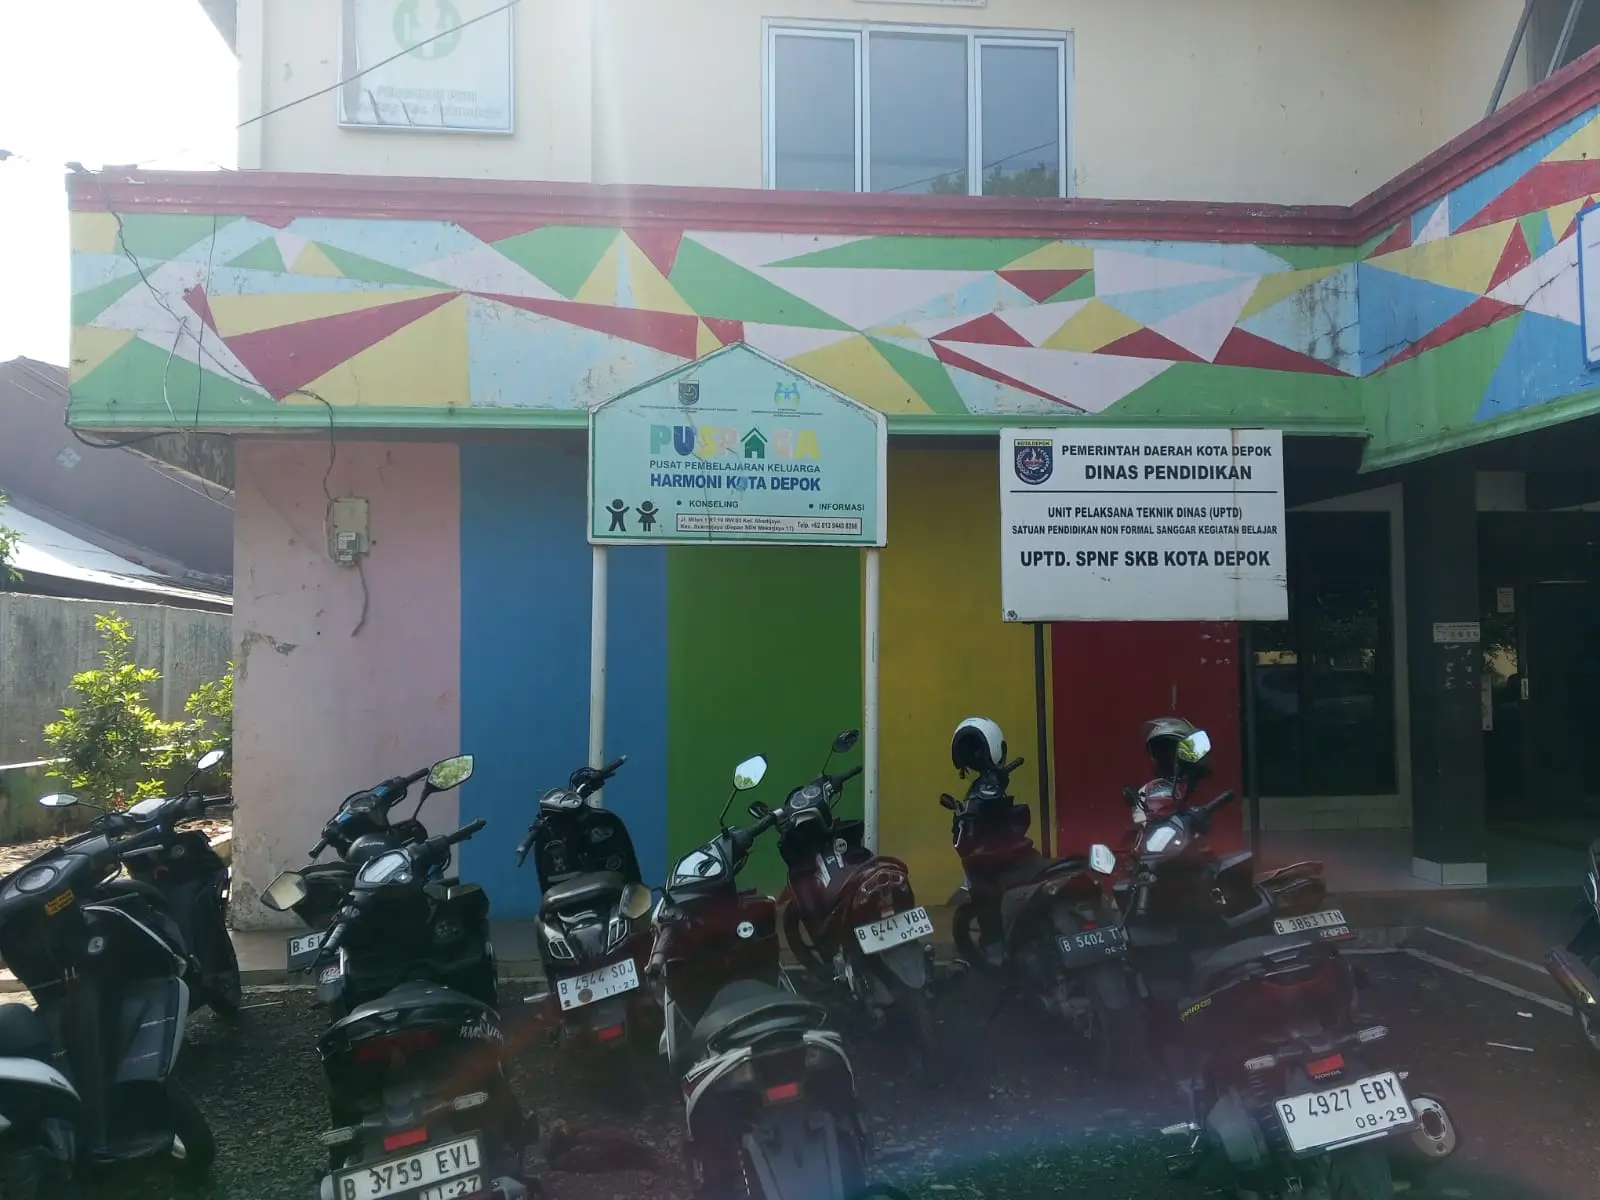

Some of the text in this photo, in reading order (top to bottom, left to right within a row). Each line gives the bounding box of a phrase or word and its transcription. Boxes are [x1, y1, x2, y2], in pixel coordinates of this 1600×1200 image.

[1062, 445, 1272, 456] PEMERINTAH DAERAH KOTA DEPOK
[649, 460, 821, 473] PUSAT PEMBELAJARAN KELUARGA
[1085, 465, 1252, 480] DINAS PENDIDIKAN
[650, 473, 722, 488] HARMONI
[770, 477, 821, 491] DEPOK
[689, 500, 739, 508] KONSELING
[818, 503, 865, 511] INFORMASI
[1048, 507, 1243, 520] UNIT PELAKSANA TEKNIK DINAS (UPTD)
[1012, 525, 1278, 535] SATUAN PENDIDIKAN NON FORMAL SANGGAR KEGIATAN BELAJAR
[1020, 550, 1271, 567] UPTD. SPNF SKB KOTA DEPOK
[858, 928, 867, 940] B
[870, 919, 899, 937] 6441
[1275, 921, 1284, 933] B
[1062, 940, 1072, 952] B
[1075, 931, 1105, 949] 5402
[560, 982, 568, 995] B
[1314, 1069, 1342, 1080] HONDA
[1282, 1077, 1397, 1124] B 4927 EBY
[343, 1178, 357, 1200] B
[435, 1144, 477, 1174] EVL
